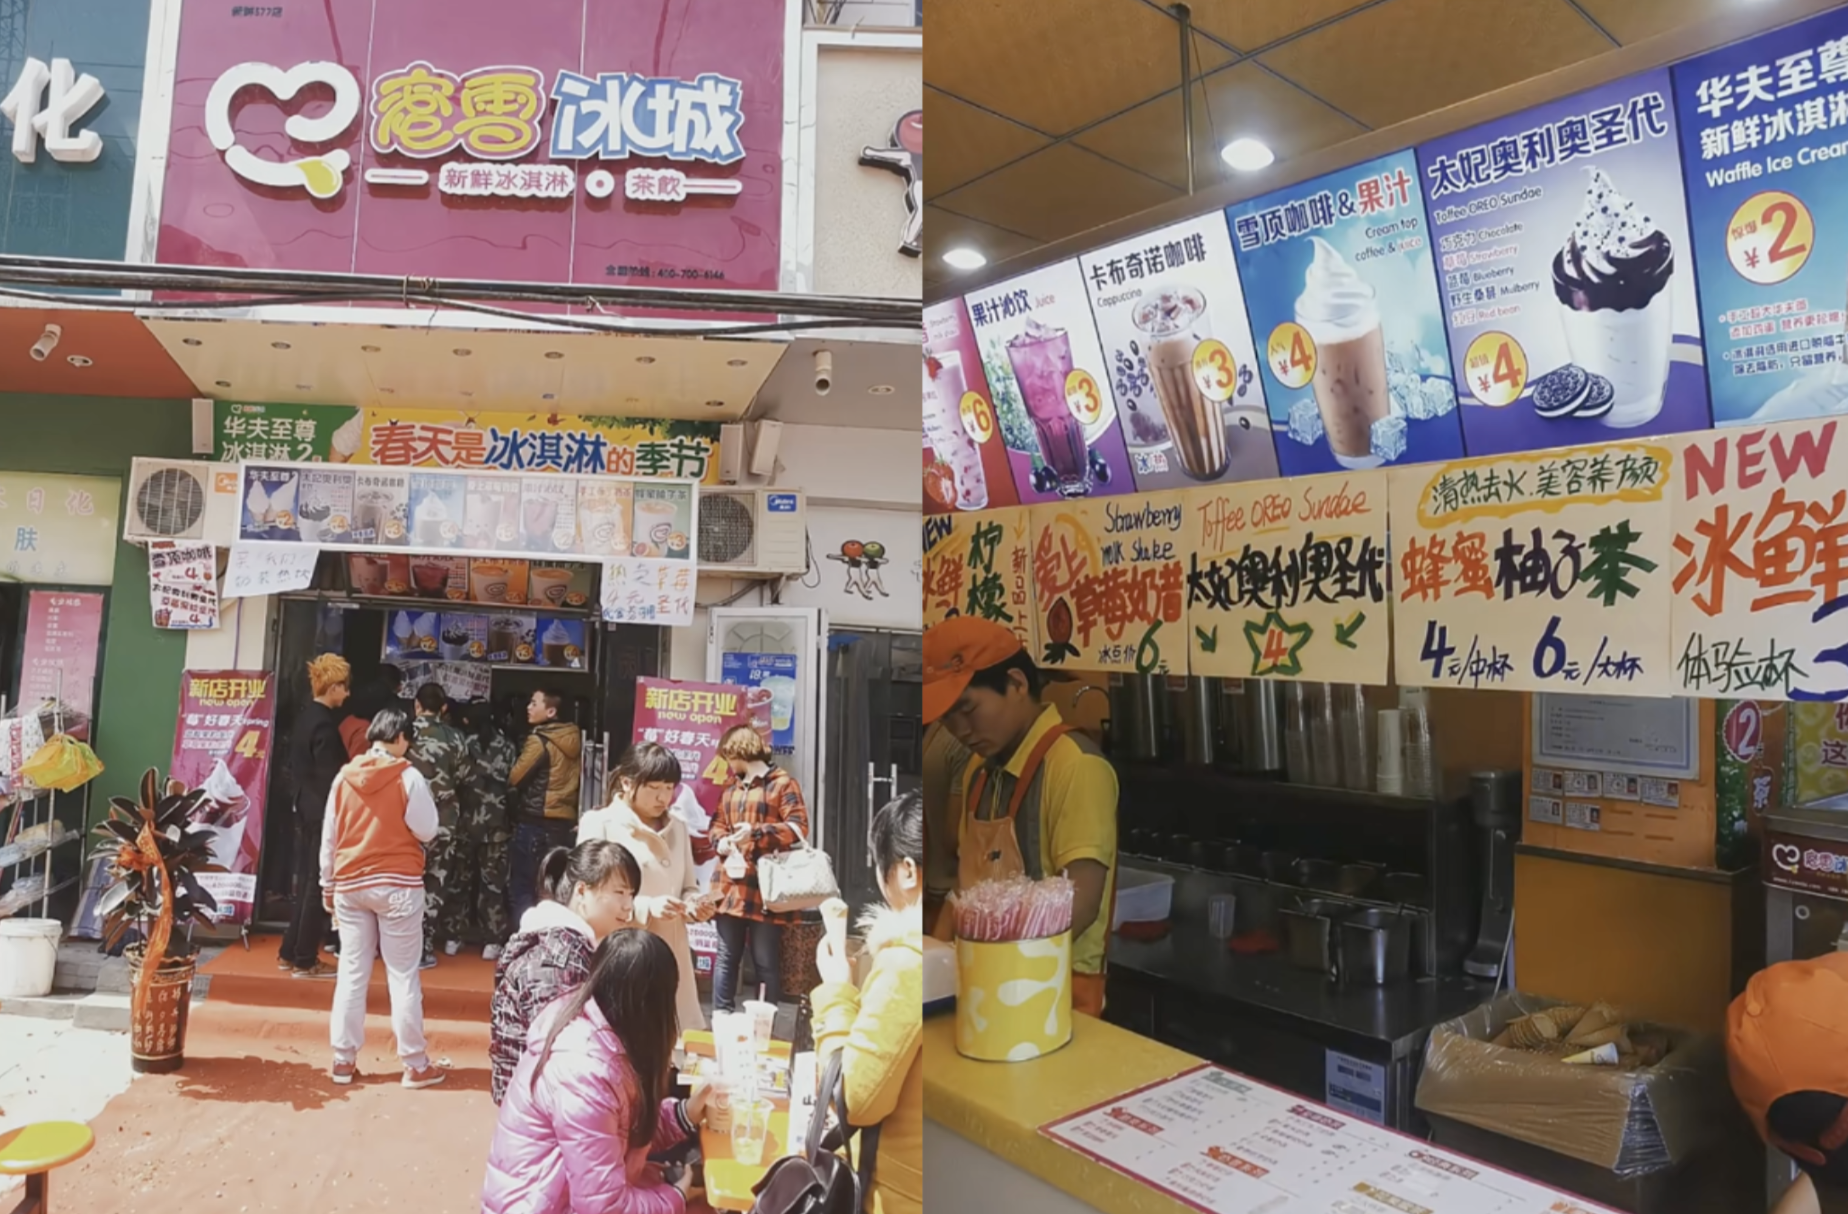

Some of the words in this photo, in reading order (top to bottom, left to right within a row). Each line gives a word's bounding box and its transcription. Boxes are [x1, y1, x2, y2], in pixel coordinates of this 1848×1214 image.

[1696, 34, 1848, 119] 华夫至尊
[0, 57, 104, 163] 化
[370, 62, 746, 164] 蜜雪冰城
[1700, 90, 1848, 160] 新鲜冰淇淋
[1429, 92, 1668, 197] 太妃奥利奥圣代
[1705, 160, 1763, 188] Waffle
[1767, 155, 1793, 174] Ice
[1436, 206, 1467, 222] Toffee
[1469, 197, 1498, 214] OREO
[1500, 187, 1542, 206] Sundae
[1365, 224, 1399, 239] Cream
[1401, 217, 1418, 231] top
[1479, 222, 1523, 241] Chocolate
[1090, 232, 1206, 291] 卡布奇诺咖啡
[1355, 246, 1385, 262] coffee
[1468, 245, 1518, 263] Strawberry
[1500, 280, 1540, 297] Mulberry
[971, 288, 1032, 328] 果汁沁饮
[223, 415, 317, 441] 华夫至尊
[371, 423, 710, 477] 春天是冰淇淋的季节
[1684, 421, 1837, 501] NEW
[1104, 501, 1181, 533] Strawberry
[1198, 496, 1246, 553] Toffee
[1251, 494, 1292, 528] OREO
[1298, 480, 1372, 522] Sundae
[14, 527, 38, 552] 肤
[1131, 536, 1176, 563] shake
[1672, 487, 1848, 617] 冰鲜
[1400, 519, 1658, 607] 蜂蜜柚子茶
[1069, 560, 1183, 648] 草莓奶昔
[1262, 629, 1288, 667] 4
[1677, 632, 1807, 694] 体验杯
[189, 679, 266, 699] 新店开业
[645, 687, 737, 716] 新店开业
[702, 755, 728, 785] 4
